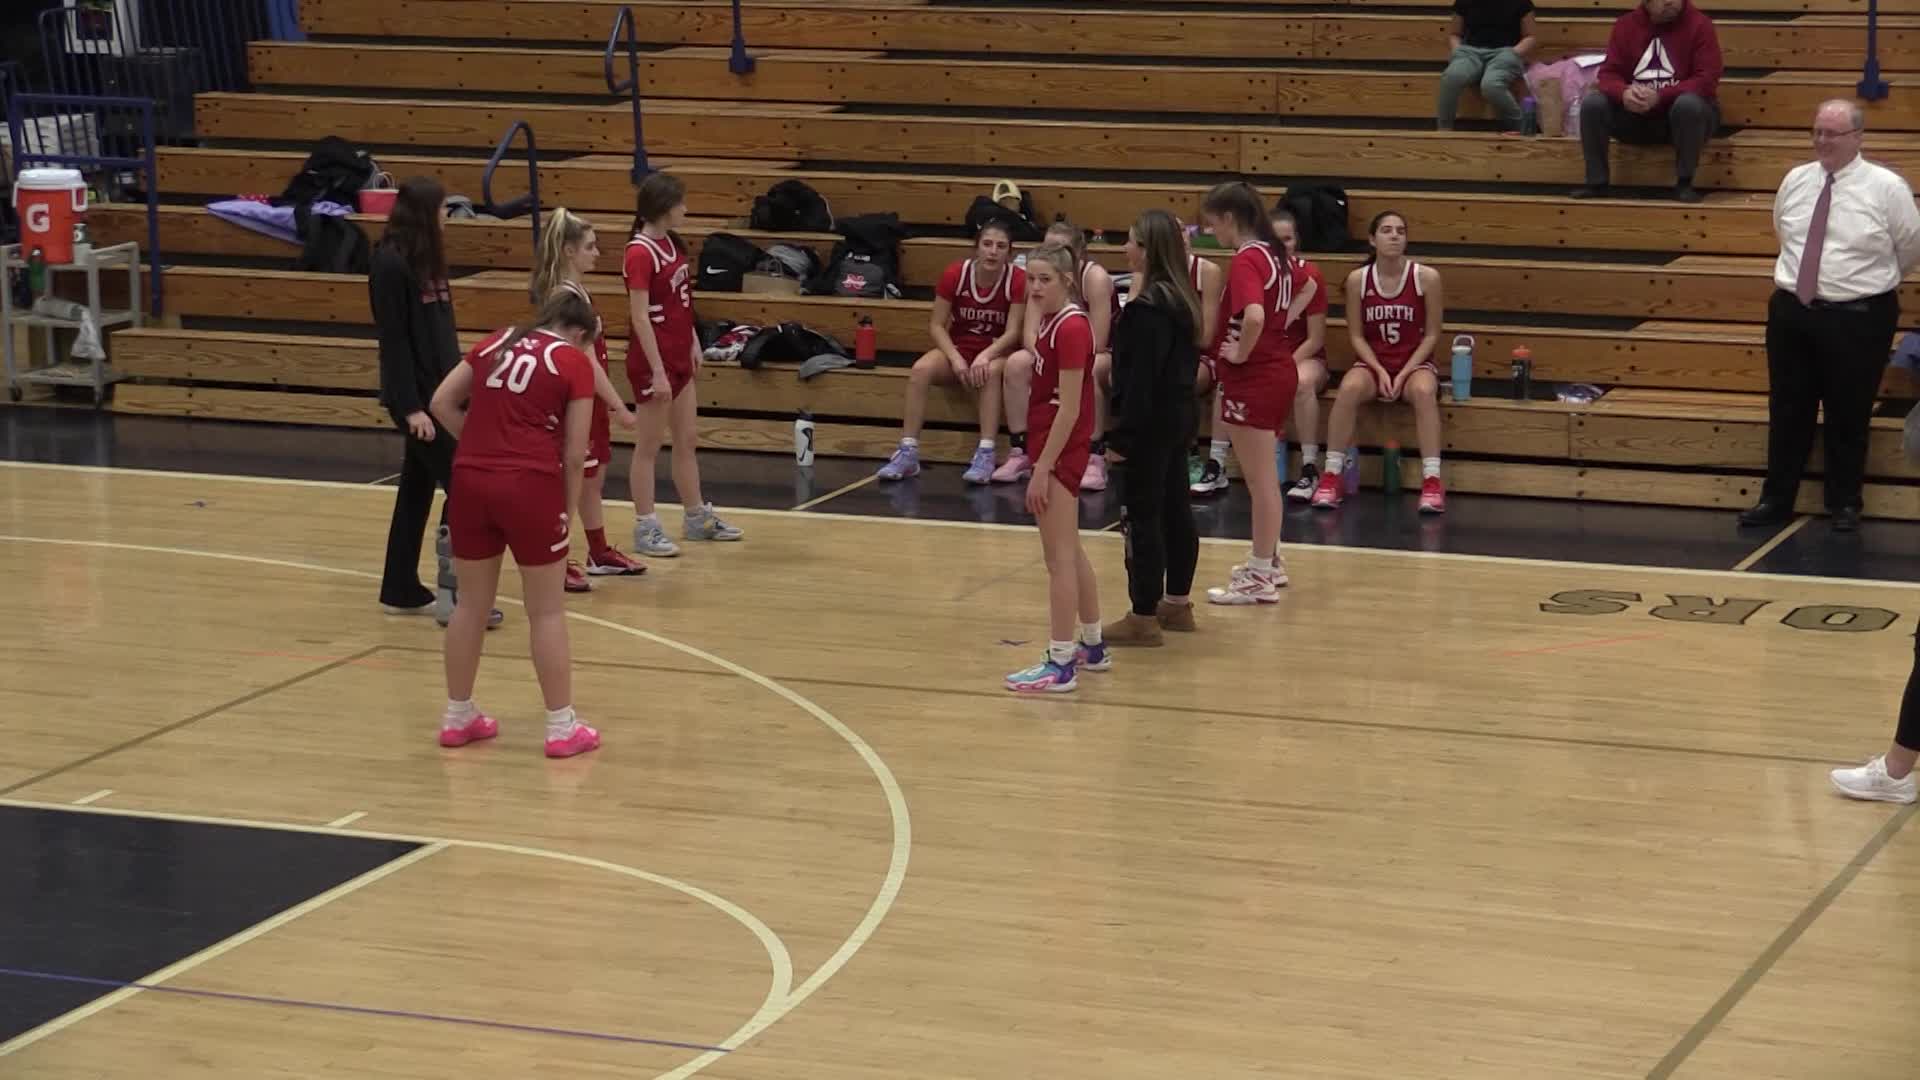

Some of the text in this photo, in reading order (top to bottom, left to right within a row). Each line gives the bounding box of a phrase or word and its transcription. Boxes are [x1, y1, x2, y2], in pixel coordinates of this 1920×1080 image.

[26, 203, 51, 233] G
[1275, 273, 1293, 313] 10
[960, 307, 1006, 324] NORTH
[1365, 304, 1414, 322] NORTH
[1379, 322, 1401, 344] 15
[486, 350, 537, 392] 20
